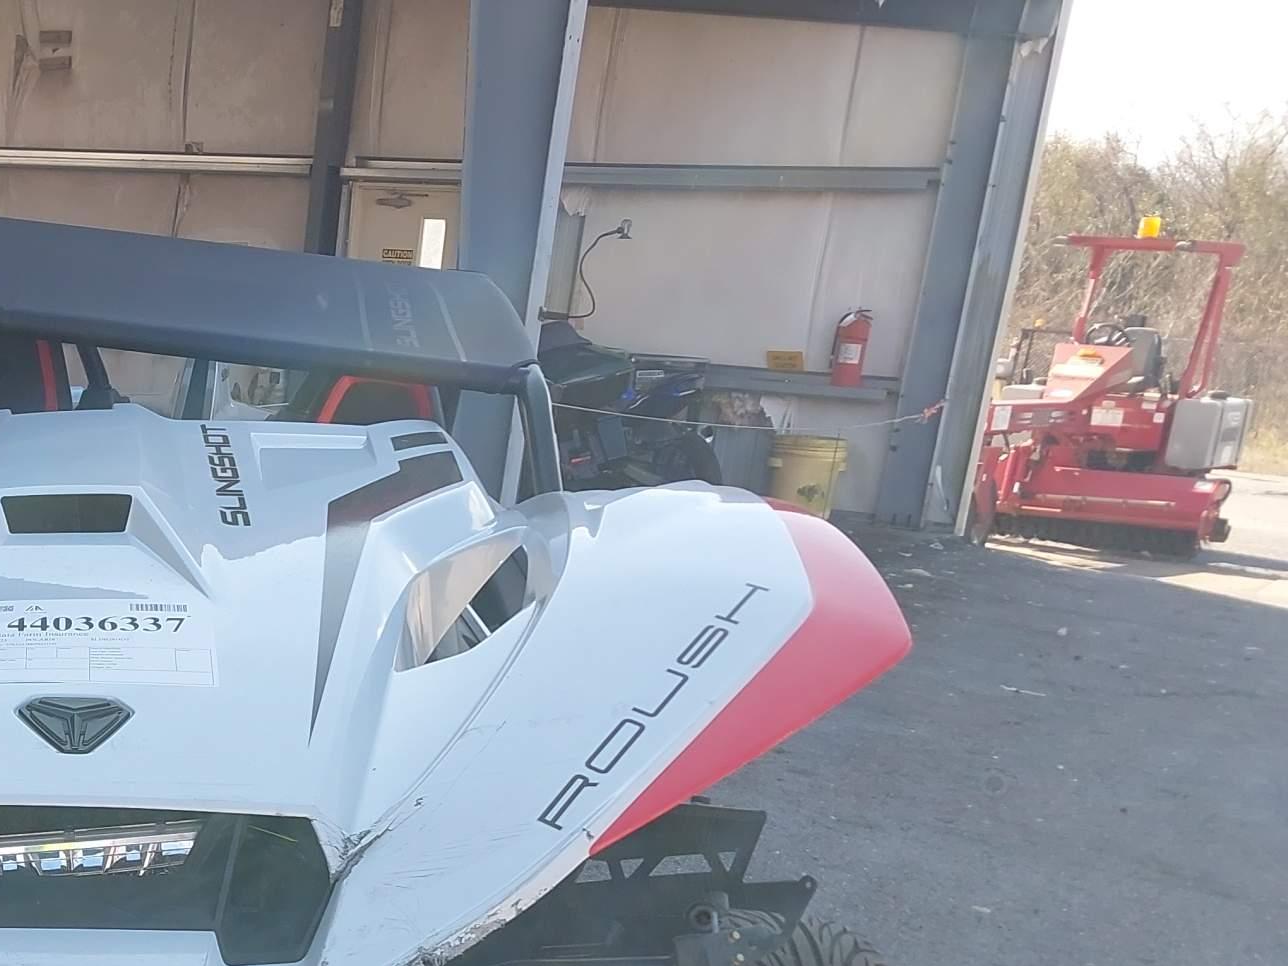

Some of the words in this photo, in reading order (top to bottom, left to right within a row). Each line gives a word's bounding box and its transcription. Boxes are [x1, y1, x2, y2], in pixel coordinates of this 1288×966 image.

[200, 423, 251, 526] SLINGSHOT
[7, 616, 185, 632] 44036337
[537, 582, 769, 831] ROUSH
